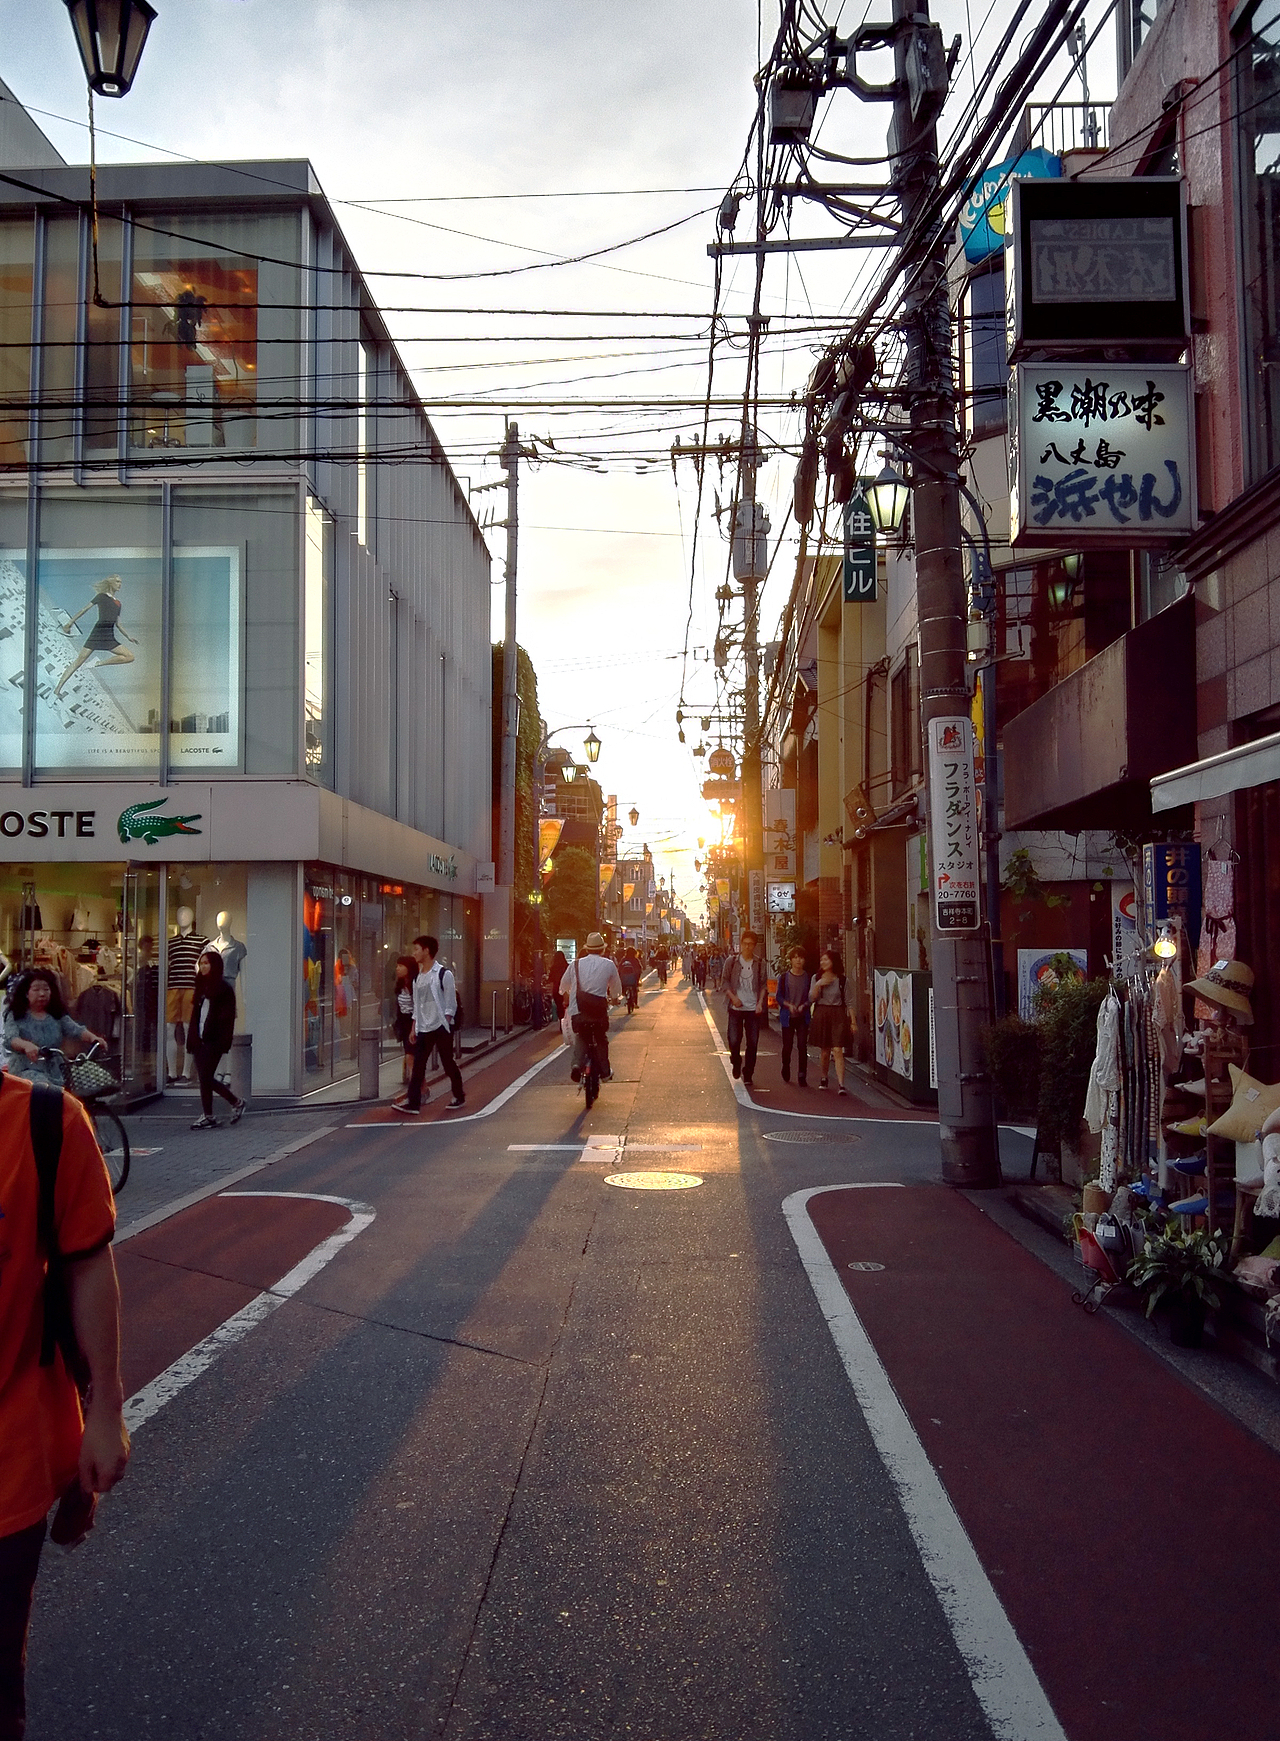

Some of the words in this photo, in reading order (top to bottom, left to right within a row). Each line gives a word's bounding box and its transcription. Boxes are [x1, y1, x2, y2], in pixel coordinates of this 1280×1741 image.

[1040, 438, 1126, 469] 八丈島
[944, 763, 963, 858] フラダンス
[0, 811, 95, 838] OSTE
[938, 861, 974, 871] スタジオ
[938, 890, 976, 899] 20-7760
[942, 908, 973, 916] 吉祥寺本町
